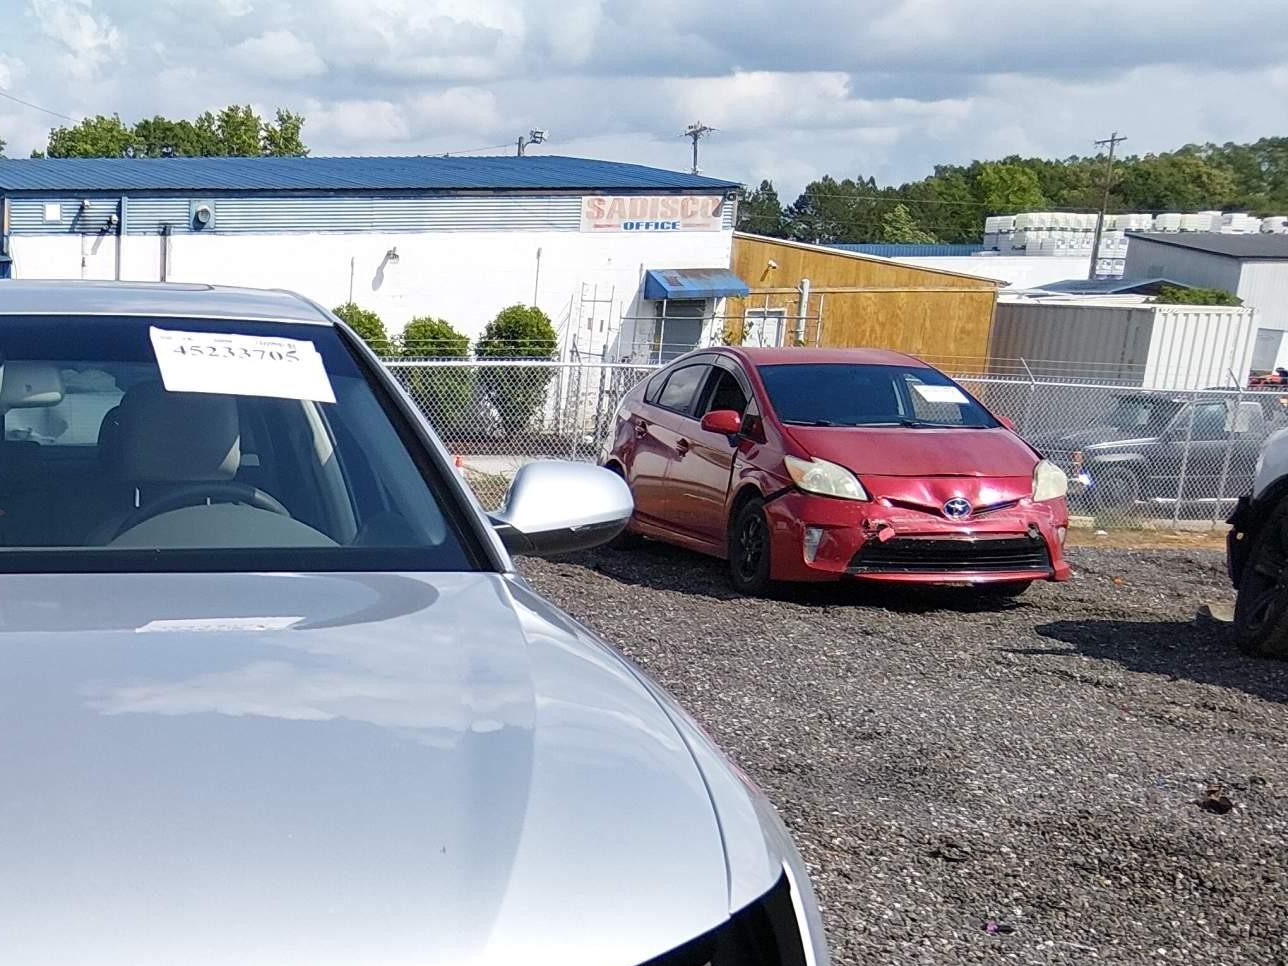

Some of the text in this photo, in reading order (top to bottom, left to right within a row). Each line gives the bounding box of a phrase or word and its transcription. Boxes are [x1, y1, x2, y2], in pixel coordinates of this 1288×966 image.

[586, 198, 721, 218] SADISCO
[623, 221, 680, 230] OFFICE
[174, 345, 300, 362] 45233705
